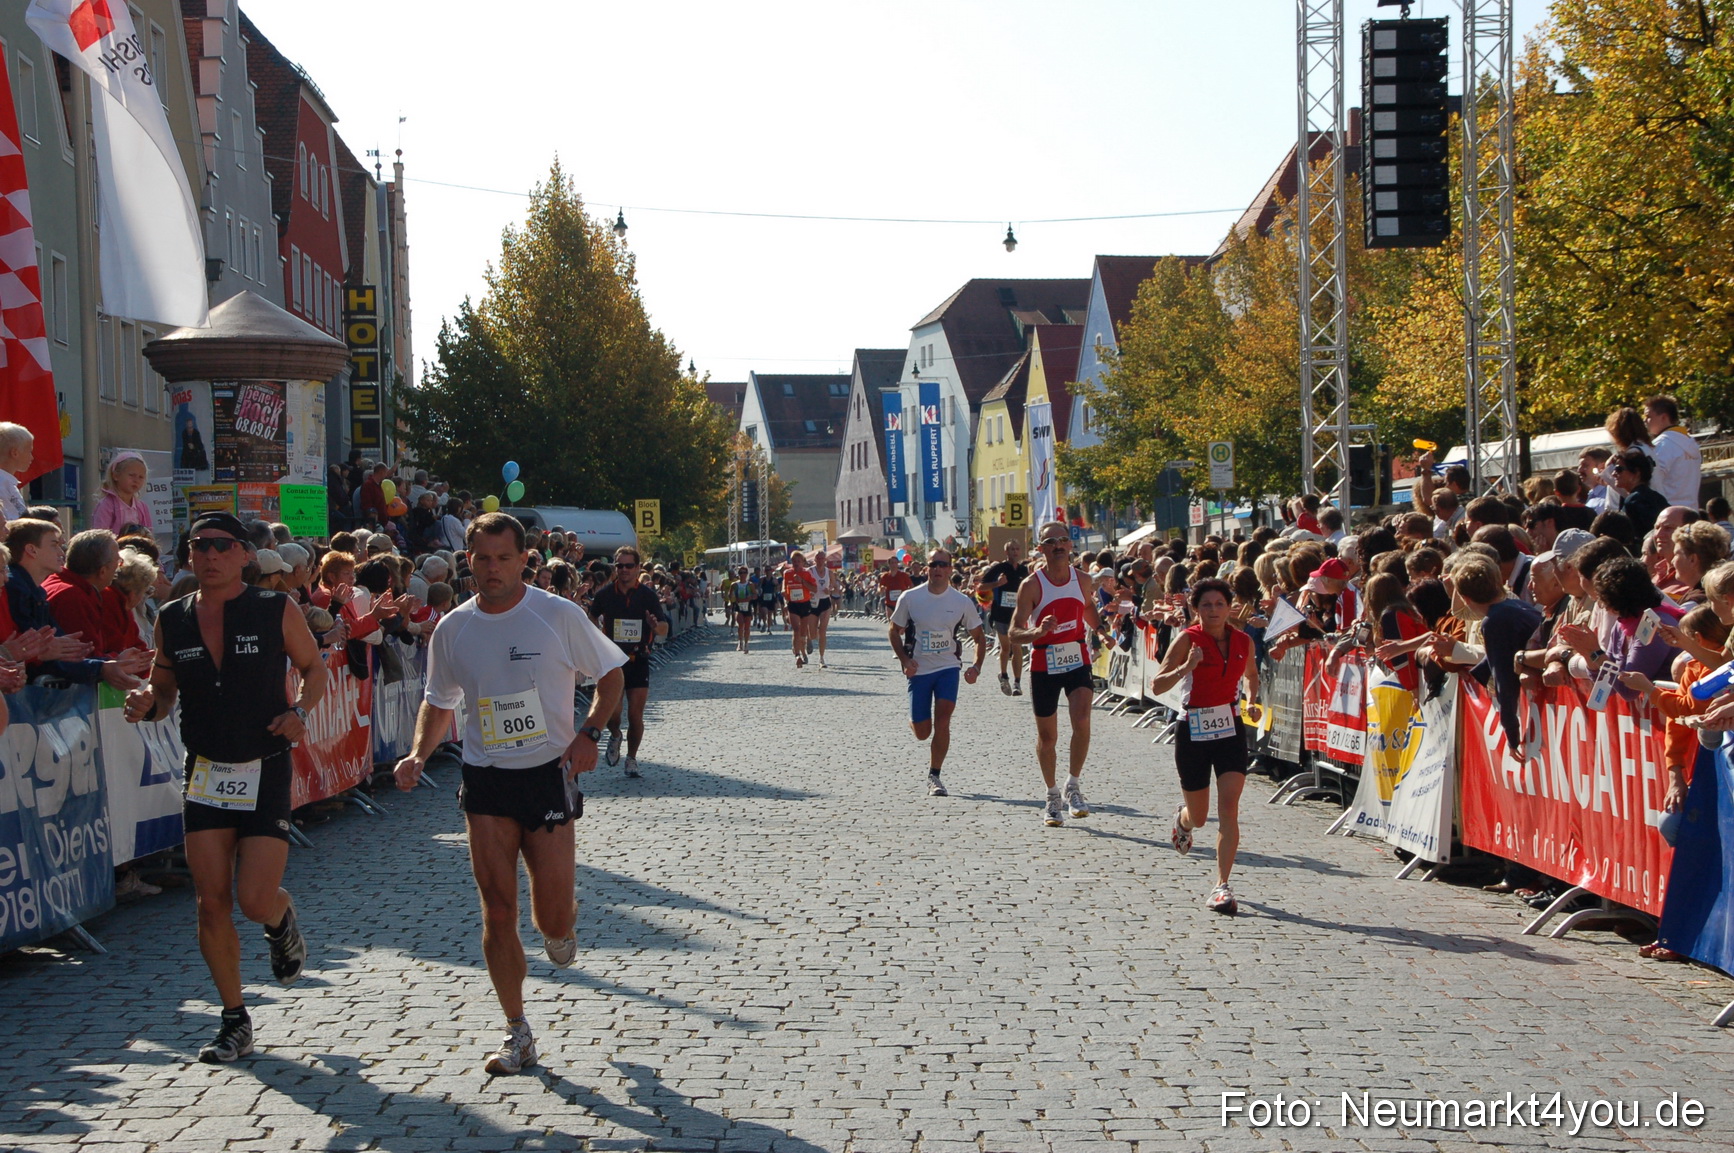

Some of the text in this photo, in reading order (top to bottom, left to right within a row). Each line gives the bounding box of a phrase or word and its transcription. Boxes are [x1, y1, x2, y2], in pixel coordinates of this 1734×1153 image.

[348, 288, 377, 445] HOTEL
[239, 399, 283, 429] ROCK
[235, 416, 279, 441] 08.09.07
[930, 427, 940, 489] K&L RUPPERT
[638, 500, 658, 508] Block
[642, 510, 655, 528] B
[1011, 503, 1023, 521] B
[686, 555, 694, 565] C
[864, 553, 872, 563] C
[235, 634, 259, 642] Team
[624, 629, 638, 637] 739
[235, 642, 259, 654] Lila
[931, 640, 950, 649] 3200
[179, 651, 201, 660] LANGE
[1057, 653, 1080, 666] 2485
[493, 700, 525, 712] Thomas
[503, 714, 536, 735] 806
[1202, 715, 1230, 731] 3431
[215, 780, 248, 796] 452
[1532, 827, 1579, 872] drink
